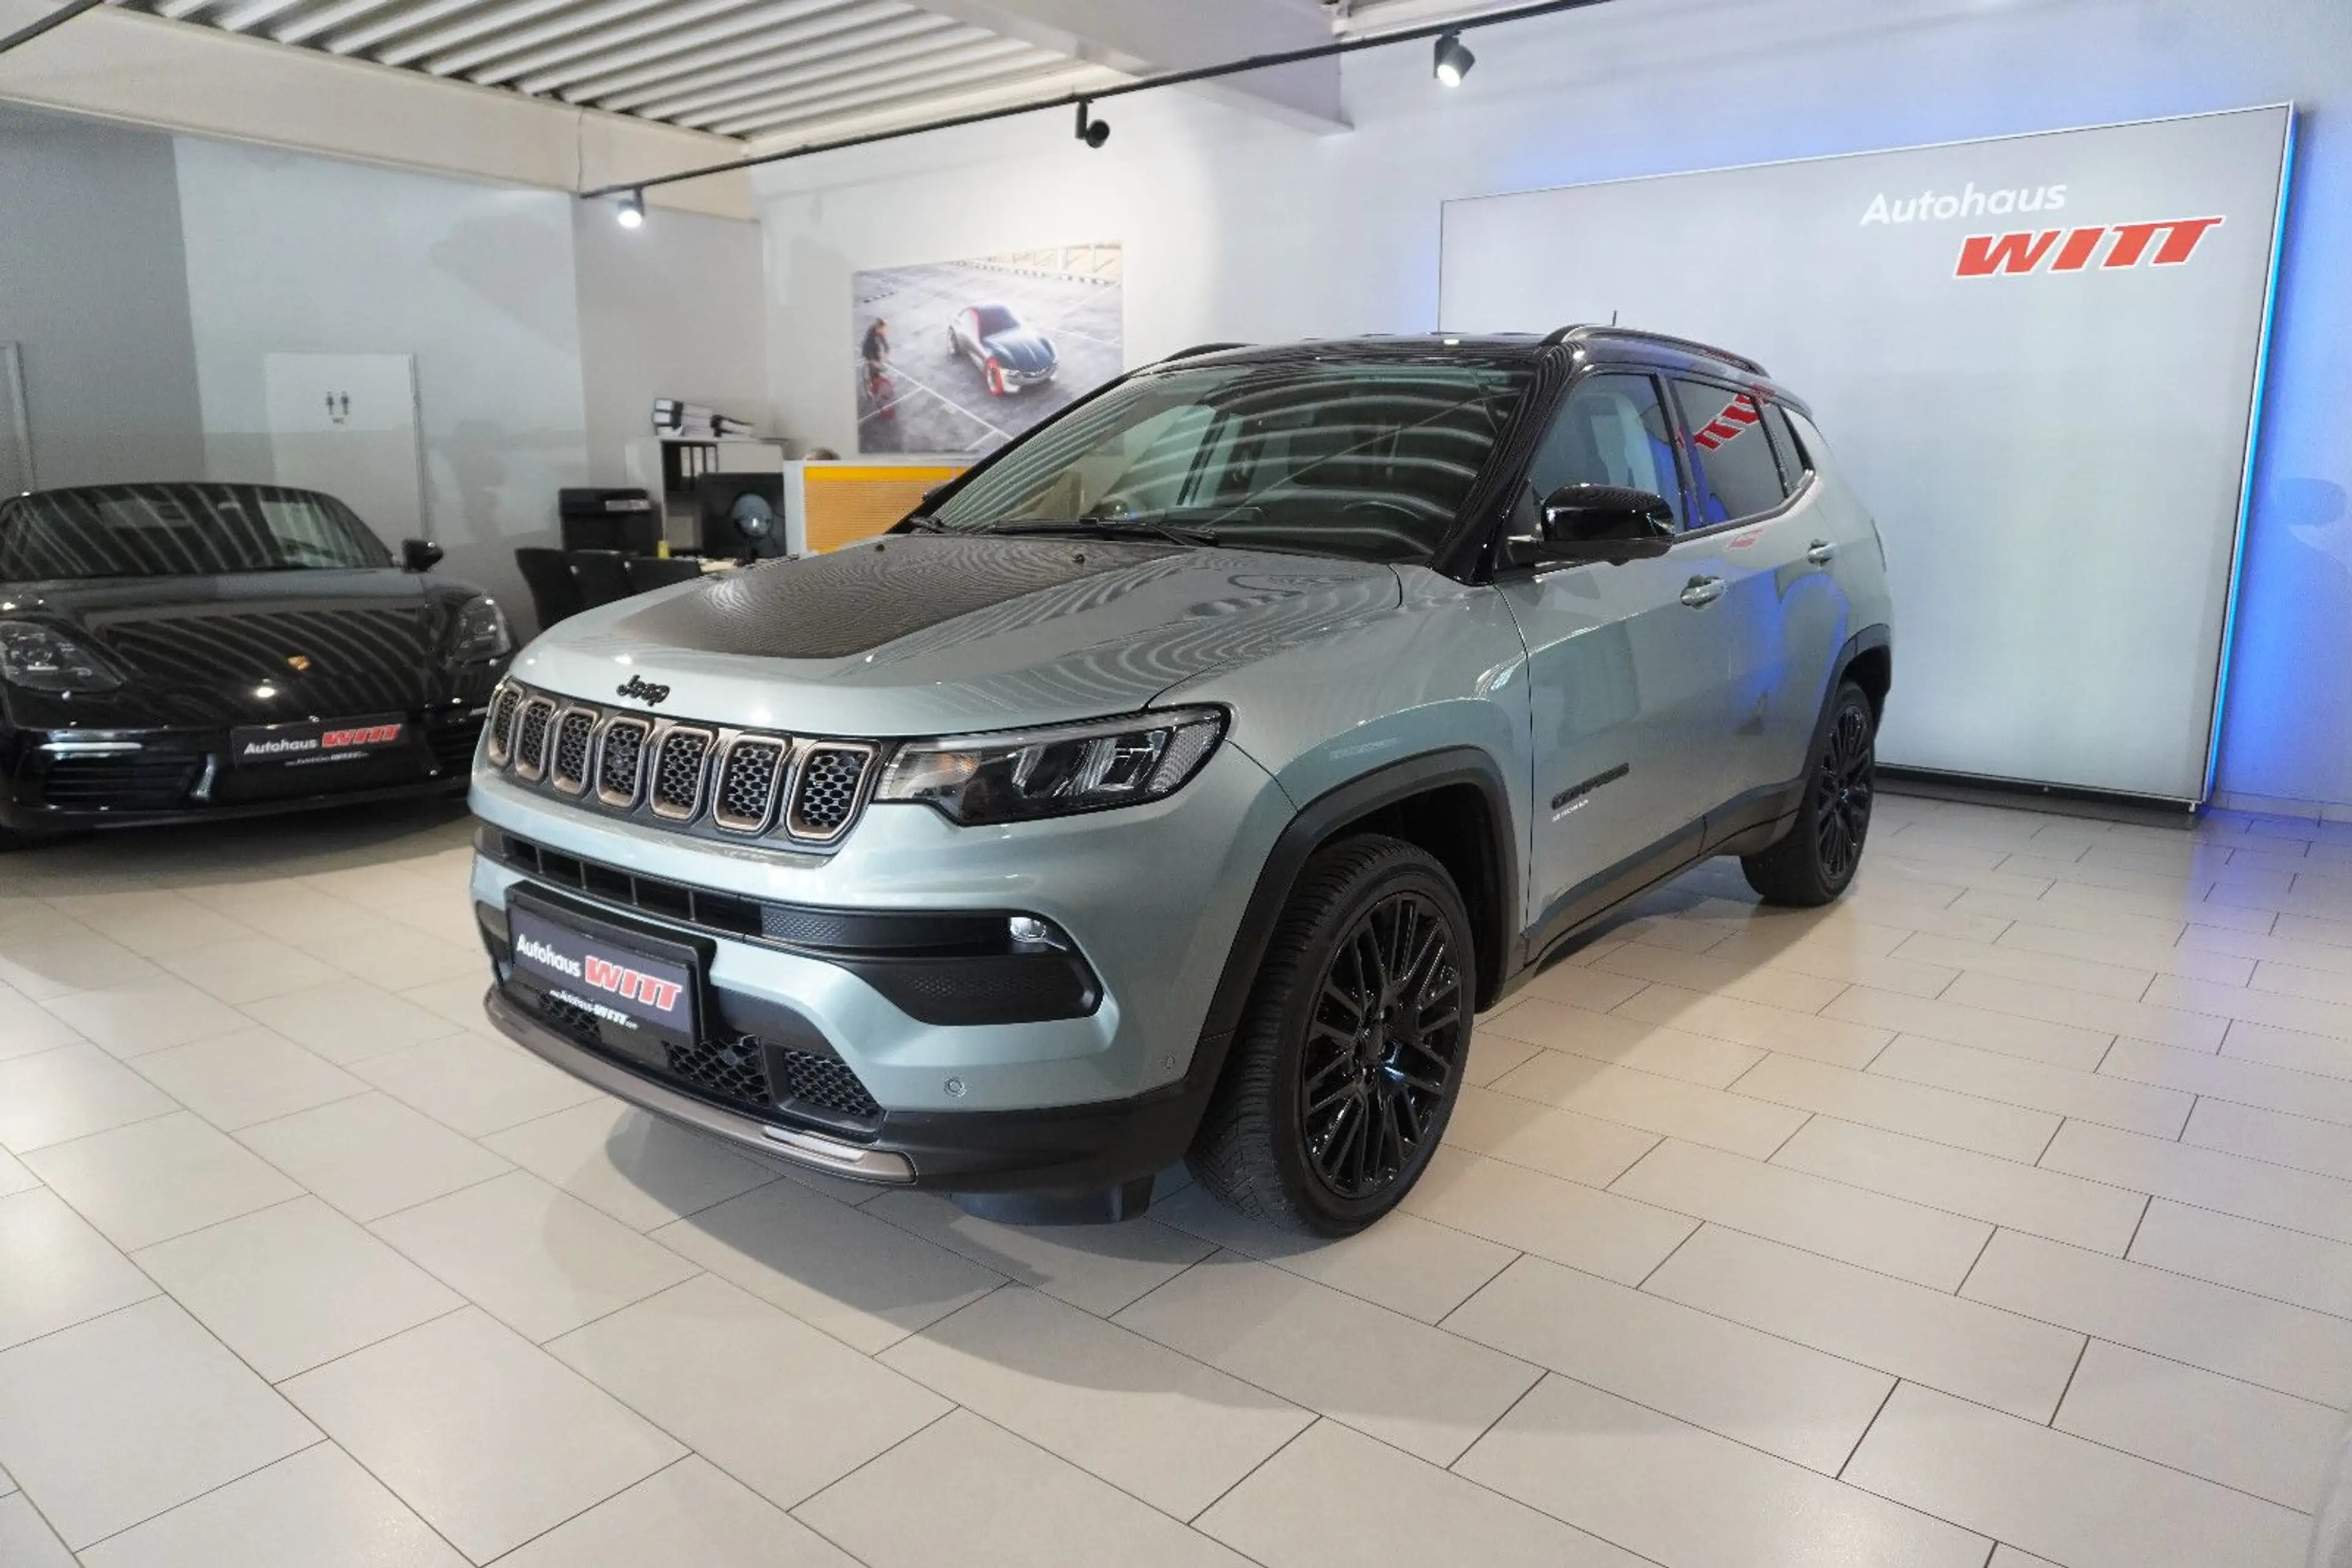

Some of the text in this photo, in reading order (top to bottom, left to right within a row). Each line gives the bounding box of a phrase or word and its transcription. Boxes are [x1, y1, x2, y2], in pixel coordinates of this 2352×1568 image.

[1859, 182, 2067, 225] Autohaus
[1953, 216, 2225, 278] WITT
[244, 723, 402, 755] Autohaus WITT
[516, 933, 581, 978] Autohaus
[585, 955, 683, 1012] WITT
